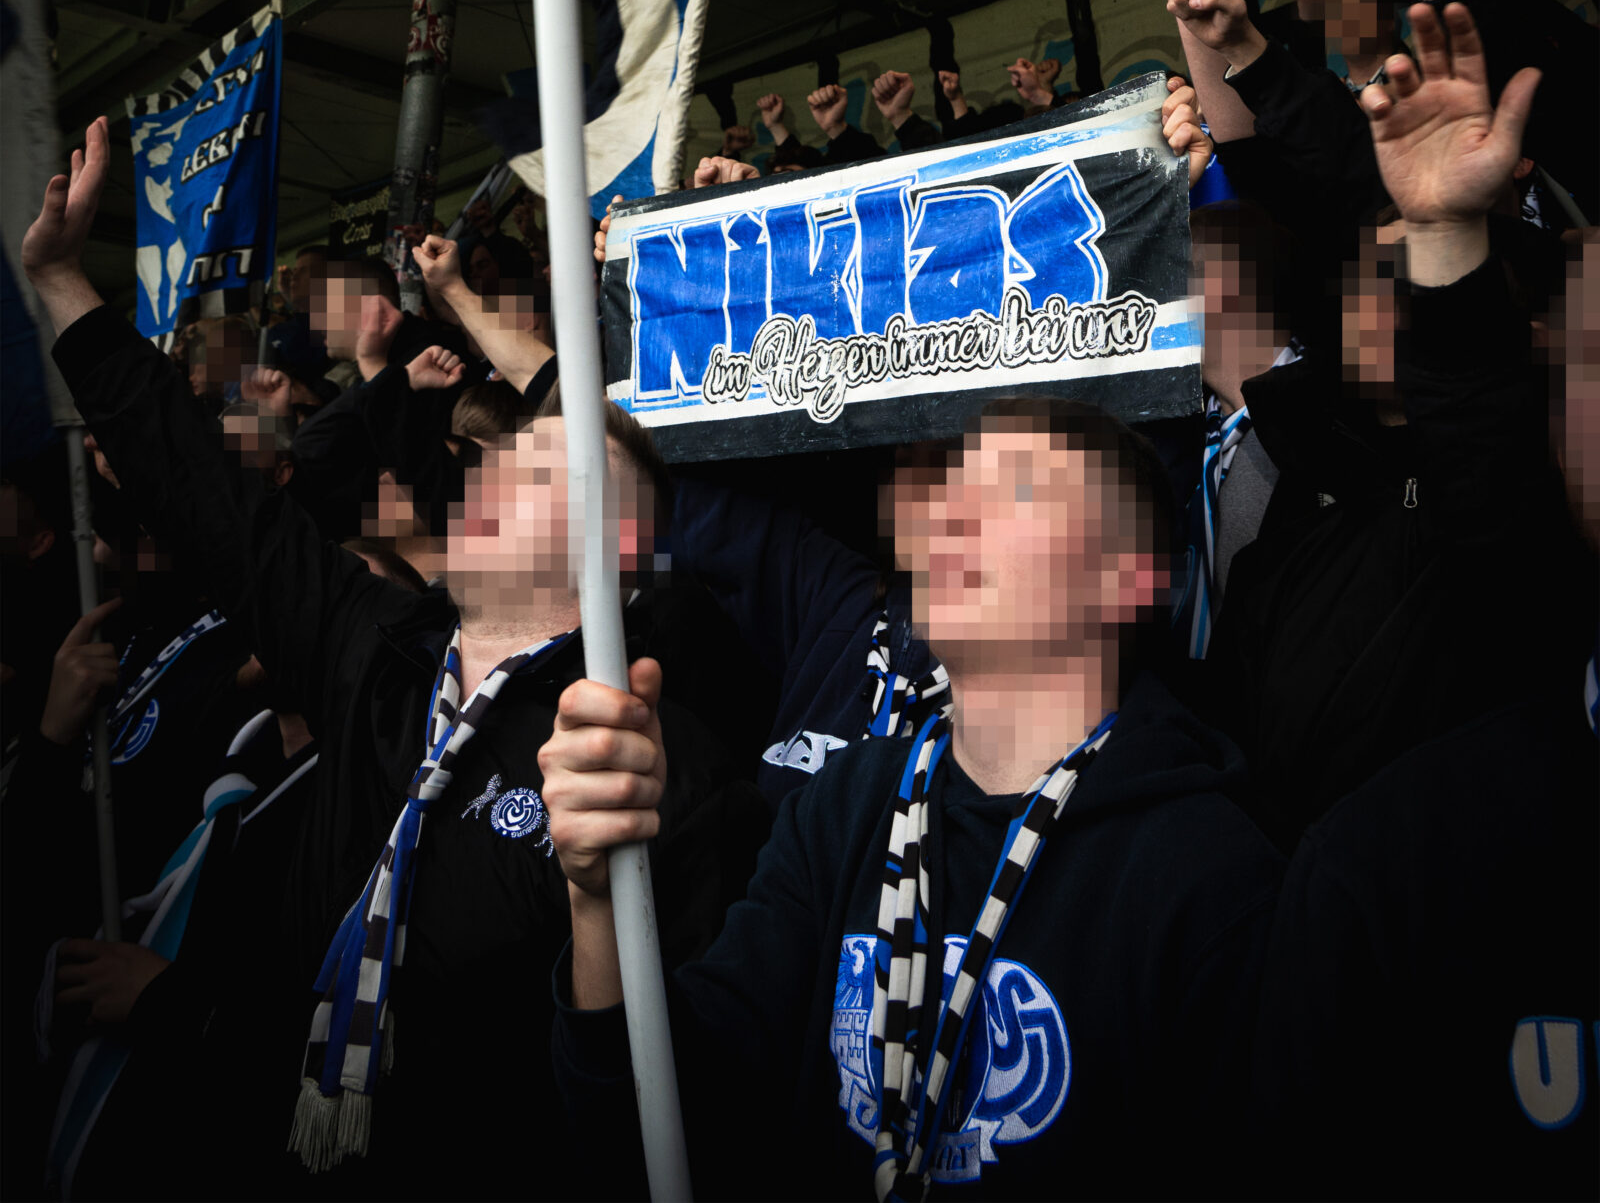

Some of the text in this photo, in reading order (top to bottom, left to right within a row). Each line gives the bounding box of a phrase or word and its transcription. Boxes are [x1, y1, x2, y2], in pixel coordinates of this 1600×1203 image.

[705, 288, 1155, 420] im Herzen immer bei uns
[491, 789, 517, 830] MEIDERICHER
[528, 790, 539, 800] 02
[511, 812, 543, 838] DUISBURG
[1508, 1015, 1600, 1131] U
